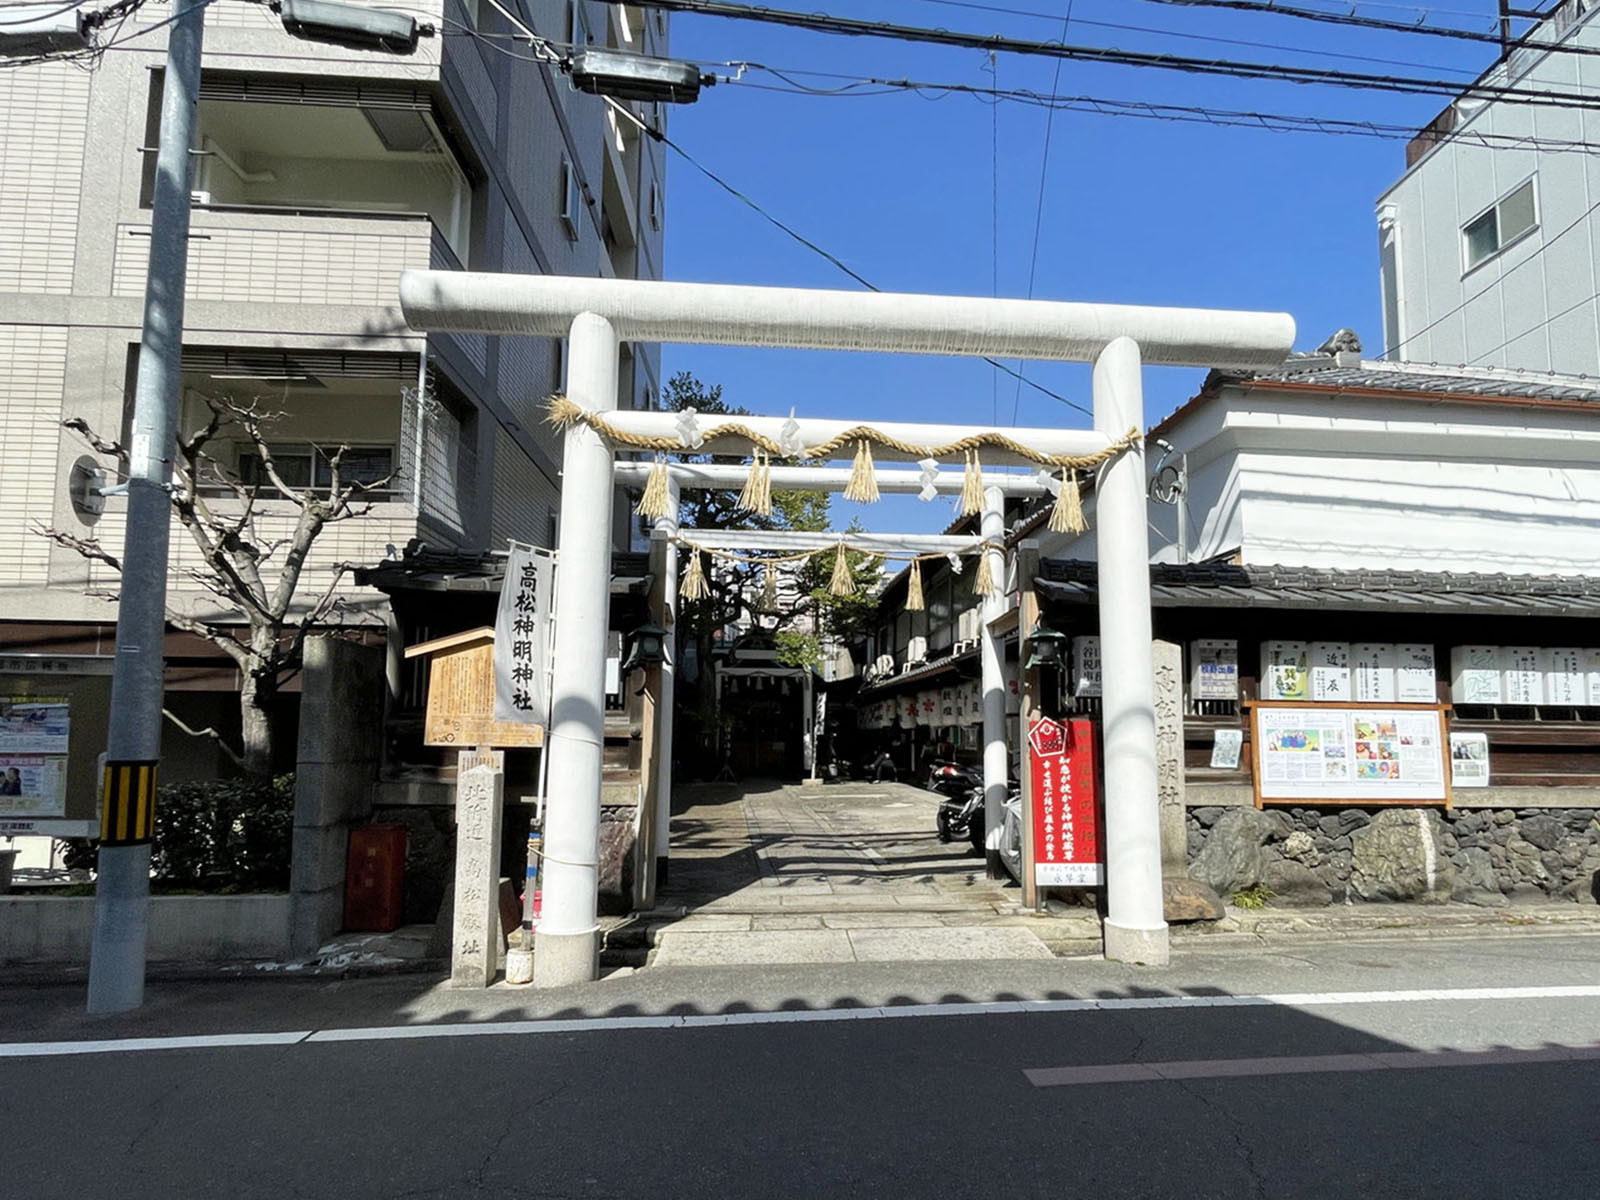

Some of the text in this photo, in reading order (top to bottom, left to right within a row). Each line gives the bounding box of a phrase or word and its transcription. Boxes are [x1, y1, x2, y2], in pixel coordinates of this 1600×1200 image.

[511, 561, 538, 711] 高松神明神社
